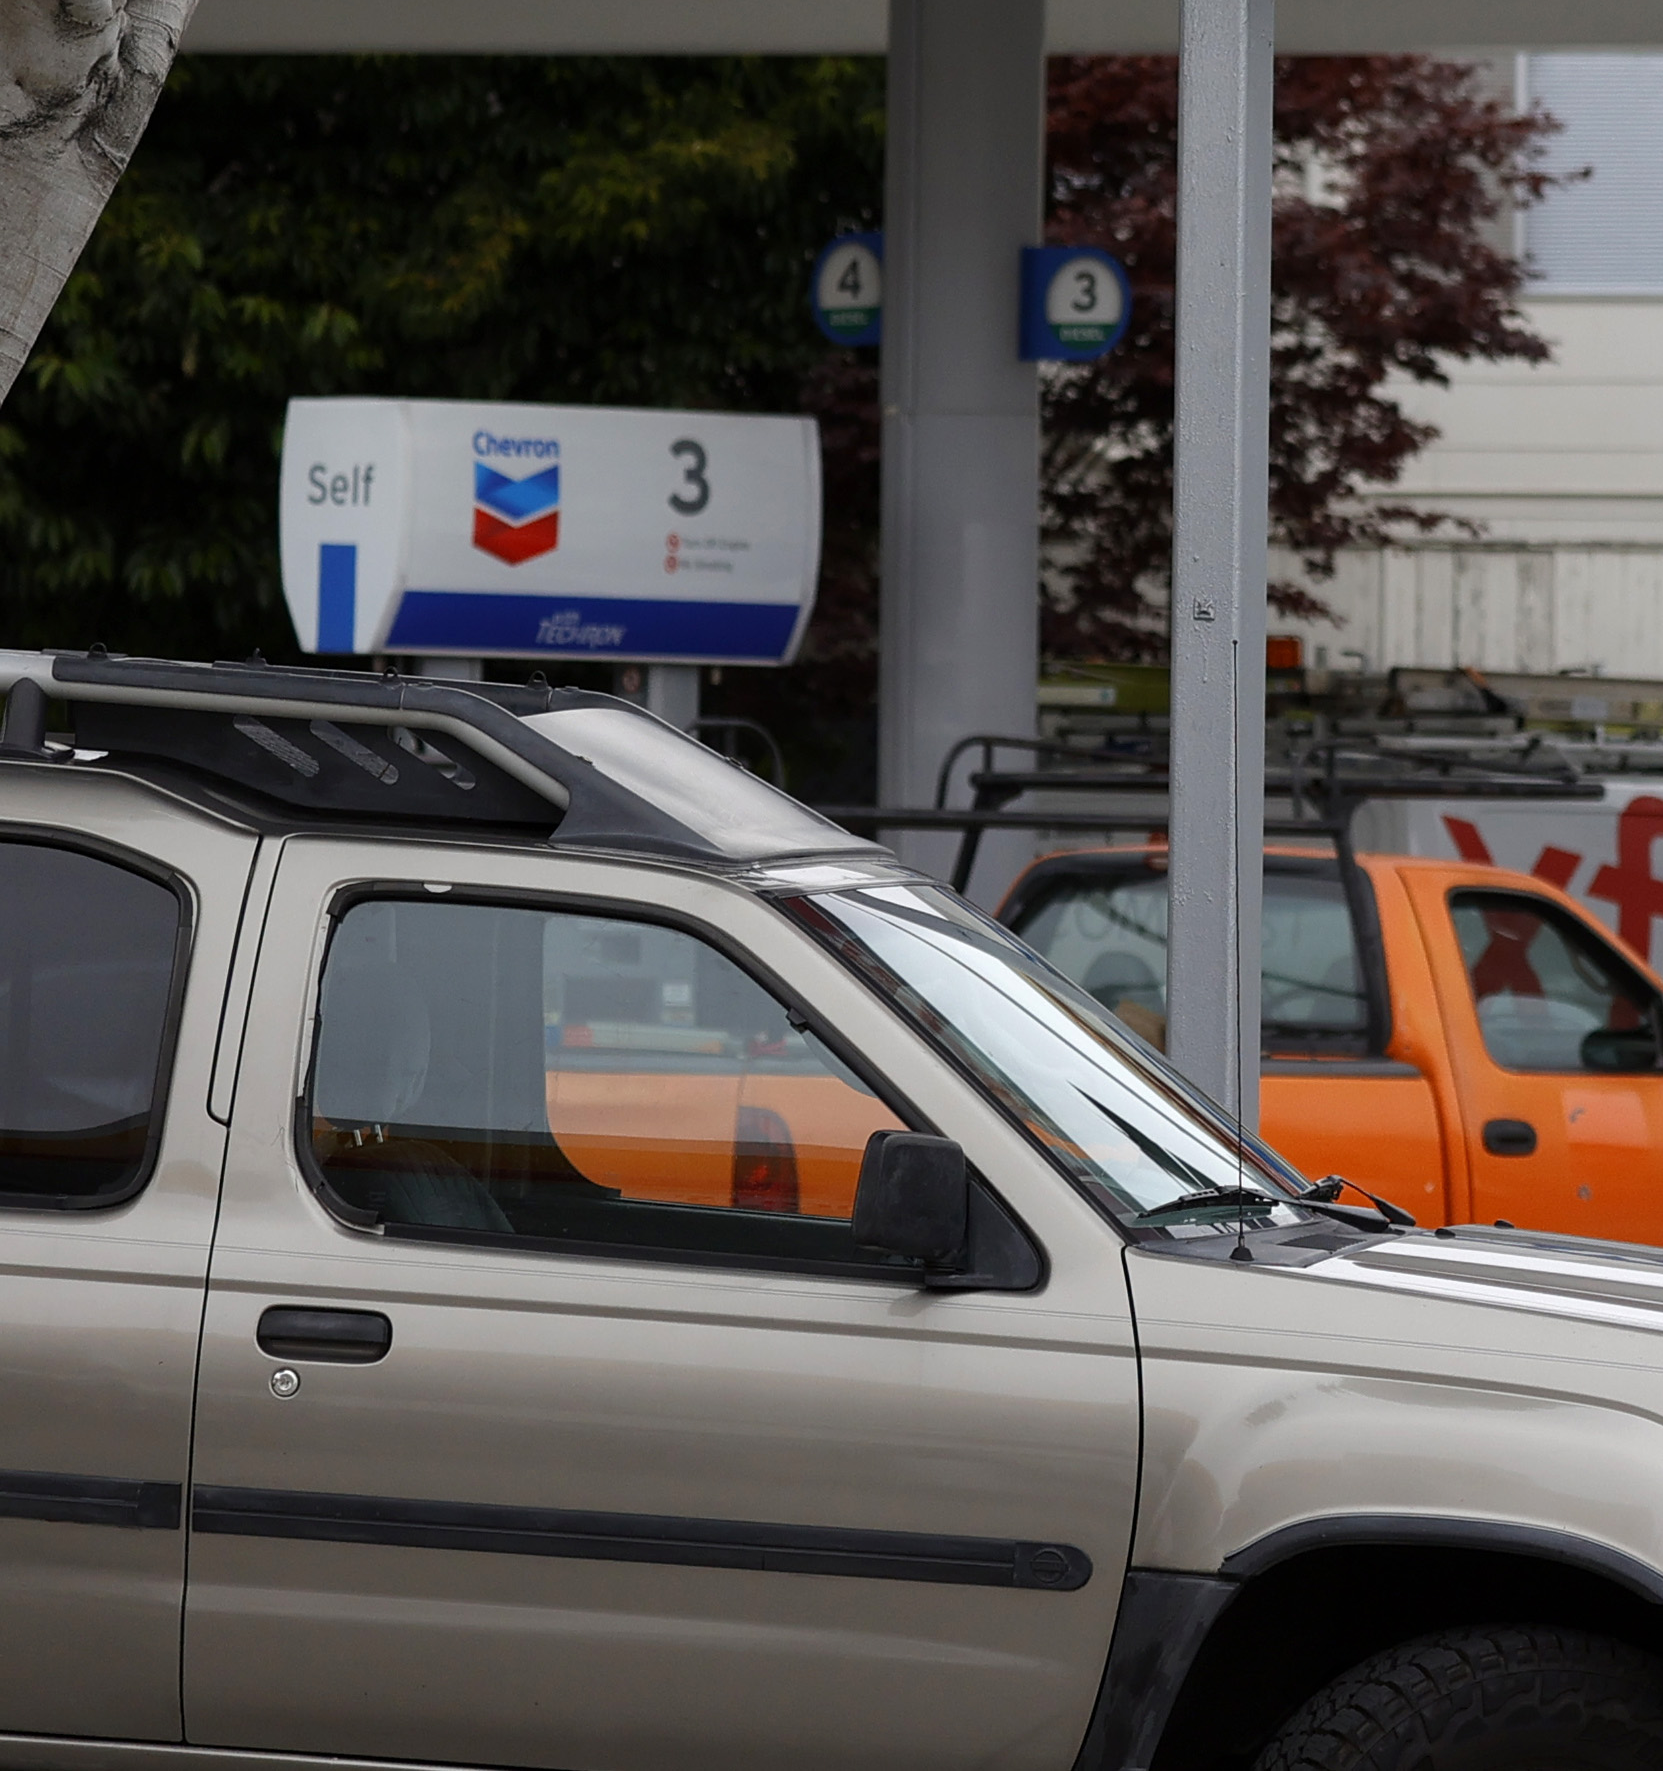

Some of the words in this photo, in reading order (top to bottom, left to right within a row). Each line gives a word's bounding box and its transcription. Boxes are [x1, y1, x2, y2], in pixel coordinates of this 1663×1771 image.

[837, 257, 862, 300] 4
[1071, 270, 1097, 313] 3
[473, 430, 560, 460] Chevron
[307, 462, 375, 508] Self
[669, 438, 711, 517] 3
